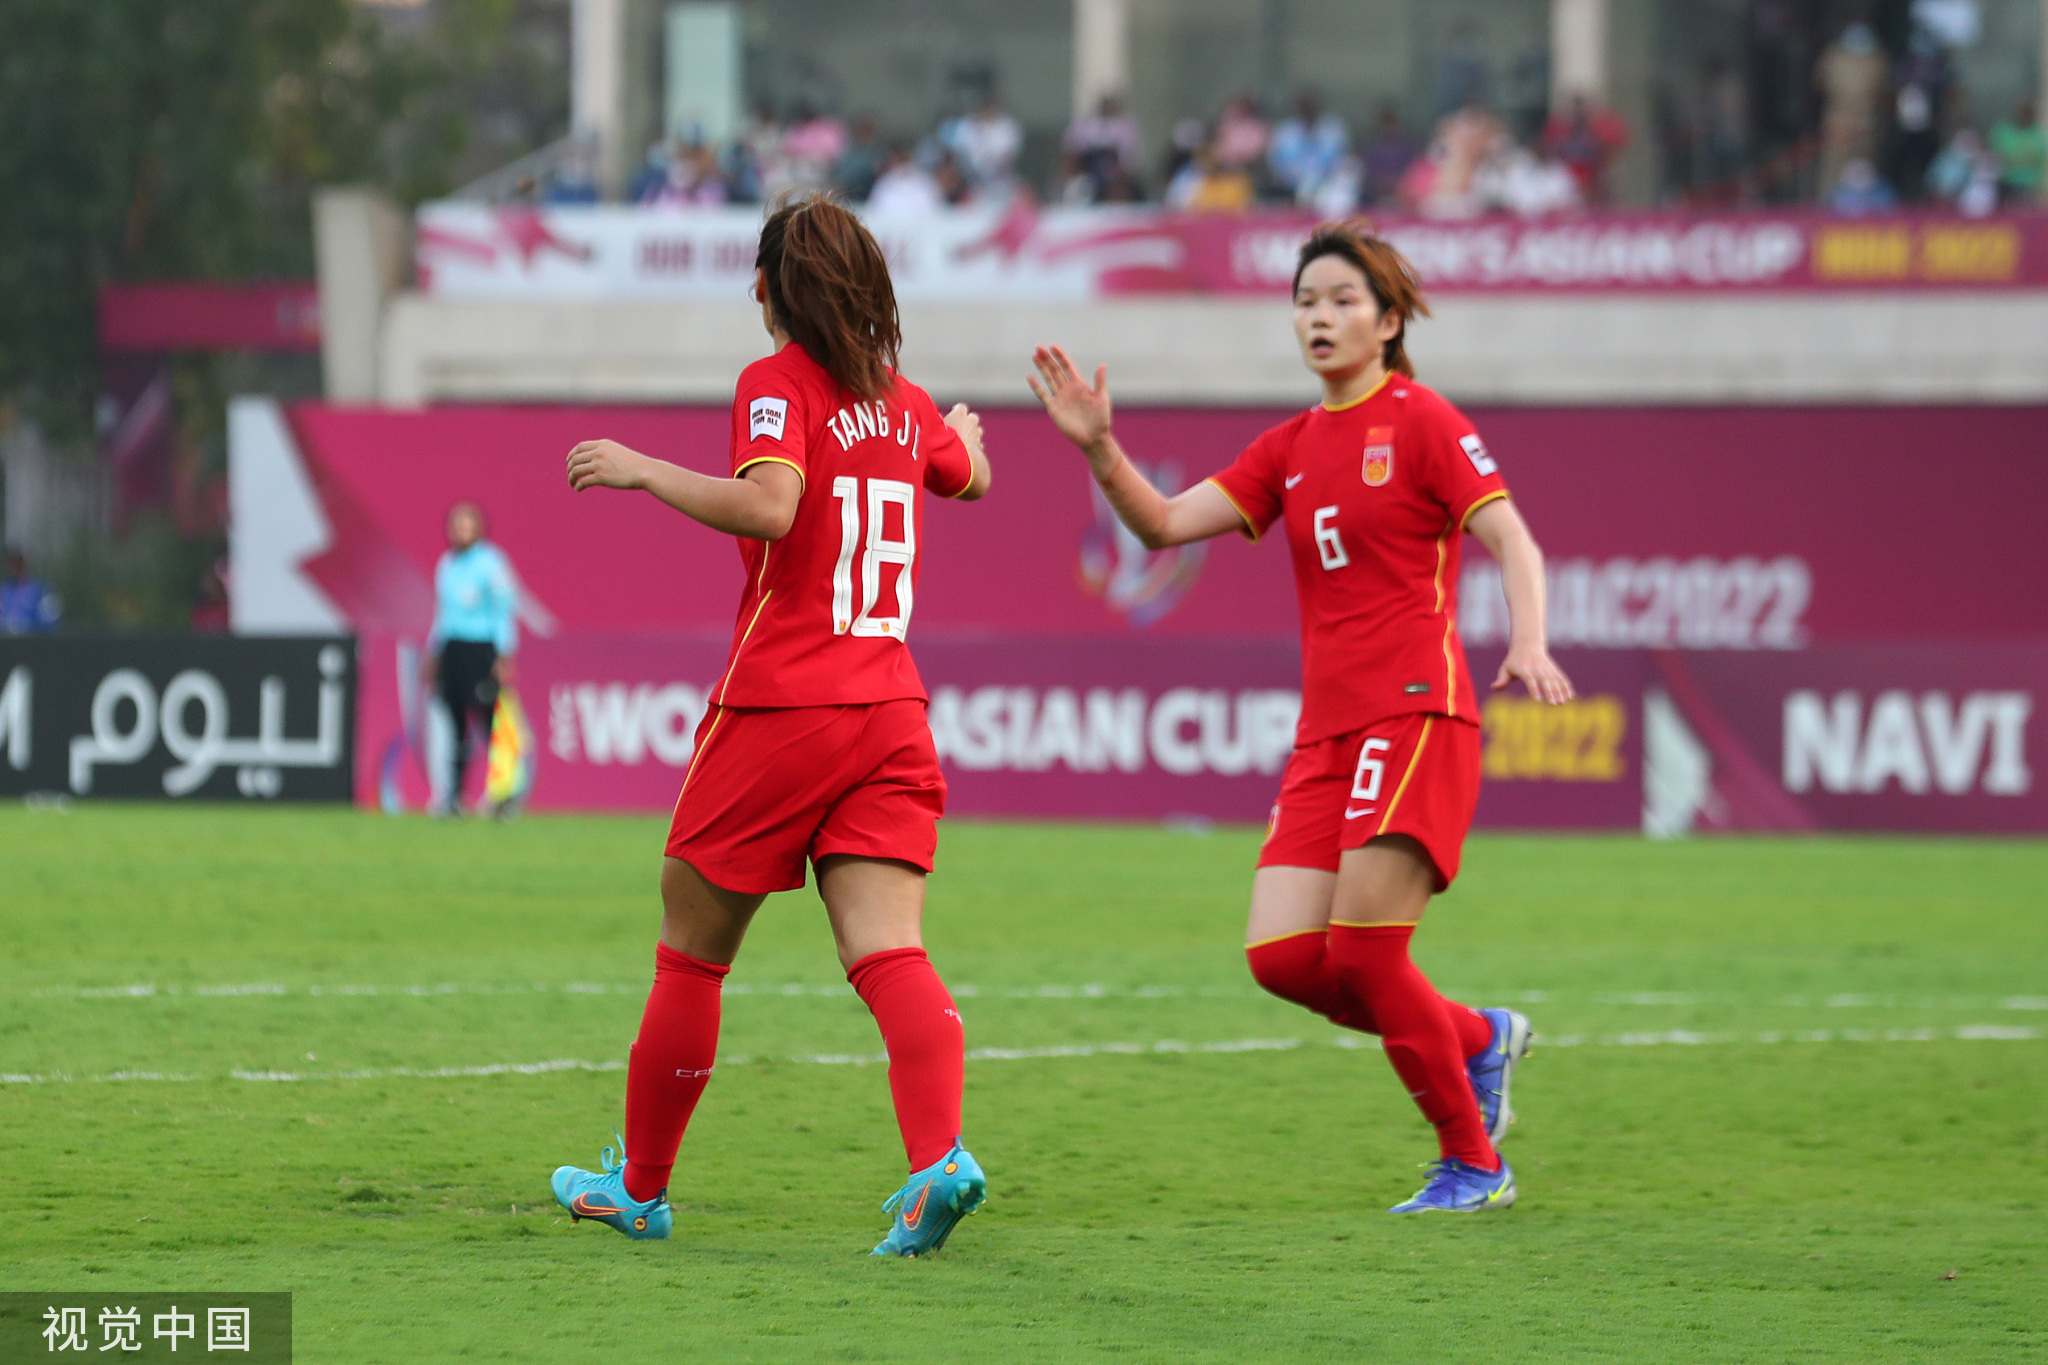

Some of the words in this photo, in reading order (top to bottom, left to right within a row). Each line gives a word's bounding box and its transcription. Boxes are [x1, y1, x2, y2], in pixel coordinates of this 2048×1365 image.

[765, 408, 783, 420] GOAL
[766, 416, 779, 427] ALL
[827, 399, 890, 452] TANG
[896, 410, 911, 447] J
[832, 475, 916, 643] 18
[1314, 505, 1350, 572] 6
[69, 643, 347, 798] نيوم
[927, 684, 1147, 773] ASIAN
[1148, 686, 1301, 776] CUP
[1782, 690, 2034, 796] NAVI
[1350, 737, 1391, 800] 6
